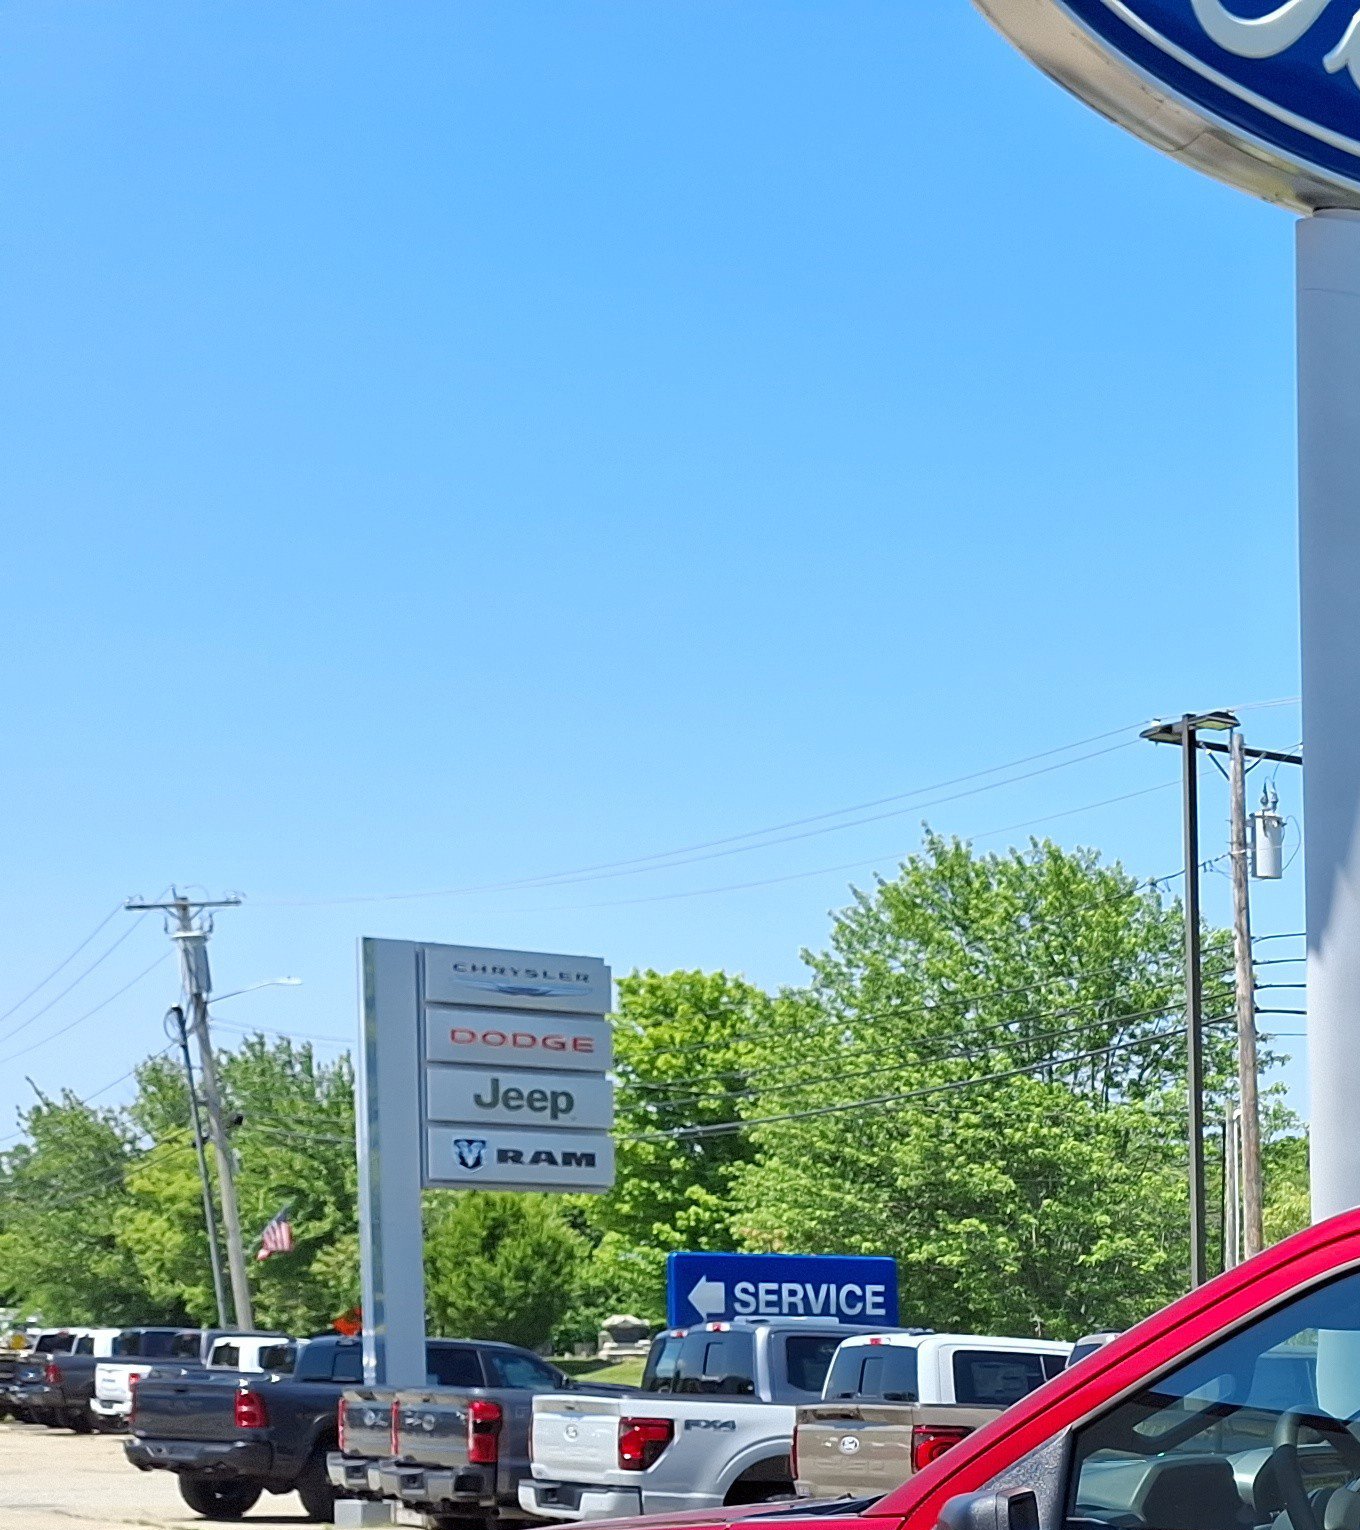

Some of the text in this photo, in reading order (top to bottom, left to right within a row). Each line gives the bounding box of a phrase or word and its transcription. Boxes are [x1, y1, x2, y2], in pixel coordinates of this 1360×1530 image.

[452, 962, 590, 984] CHRYSLER
[450, 1028, 595, 1054] DODGE
[472, 1077, 575, 1120] Jeep
[495, 1148, 597, 1168] RAM
[733, 1281, 886, 1316] SERVICE
[684, 1419, 737, 1431] FX4
